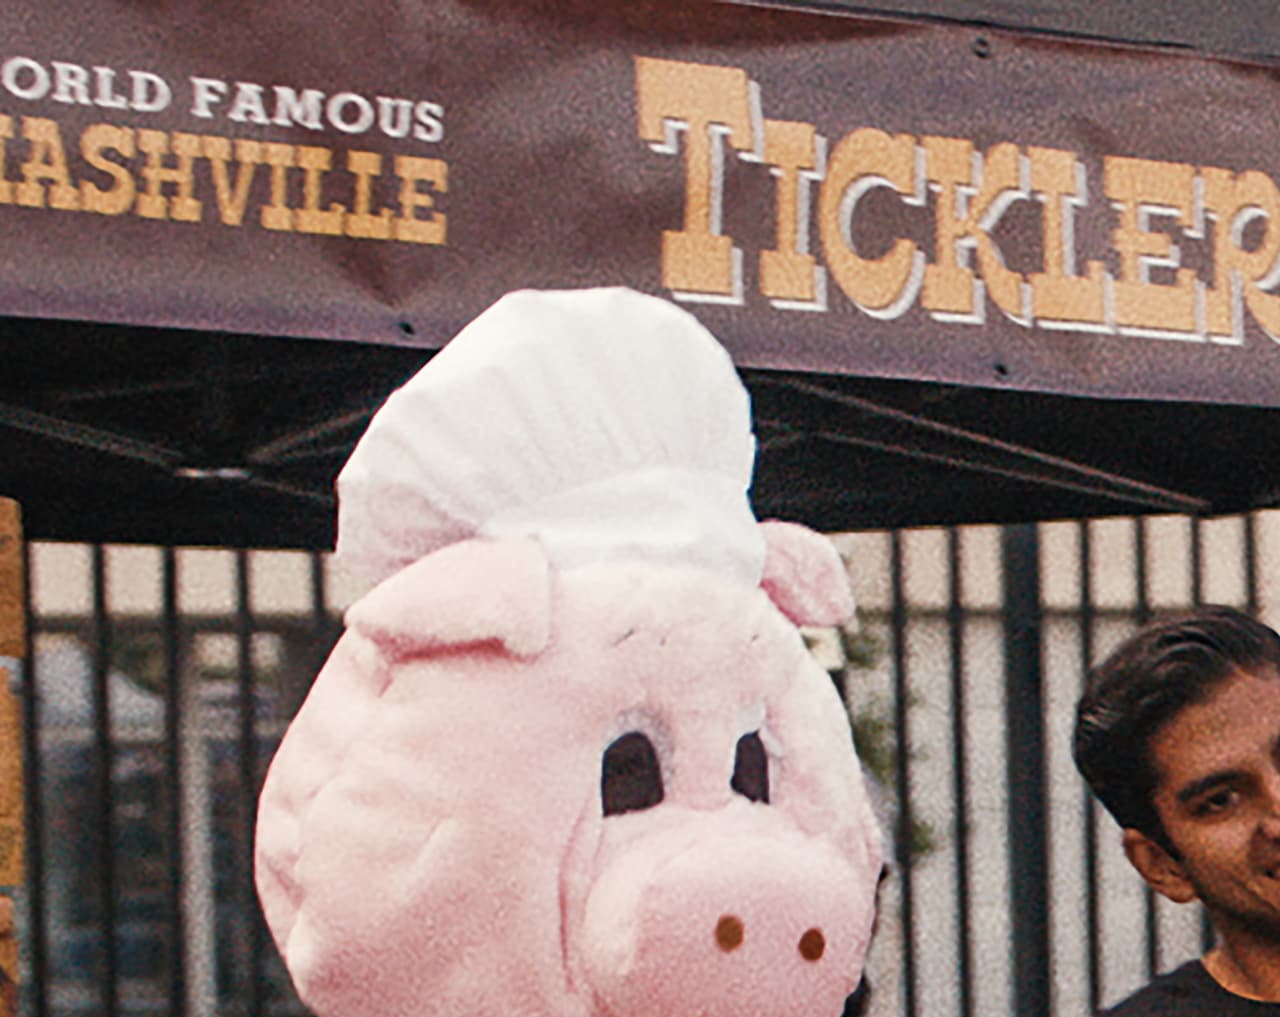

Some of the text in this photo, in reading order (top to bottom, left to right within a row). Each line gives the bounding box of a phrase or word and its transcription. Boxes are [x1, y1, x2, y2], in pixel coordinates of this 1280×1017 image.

[0, 56, 446, 143] ORLD FAMOUS
[0, 113, 448, 246] ASHVILLE
